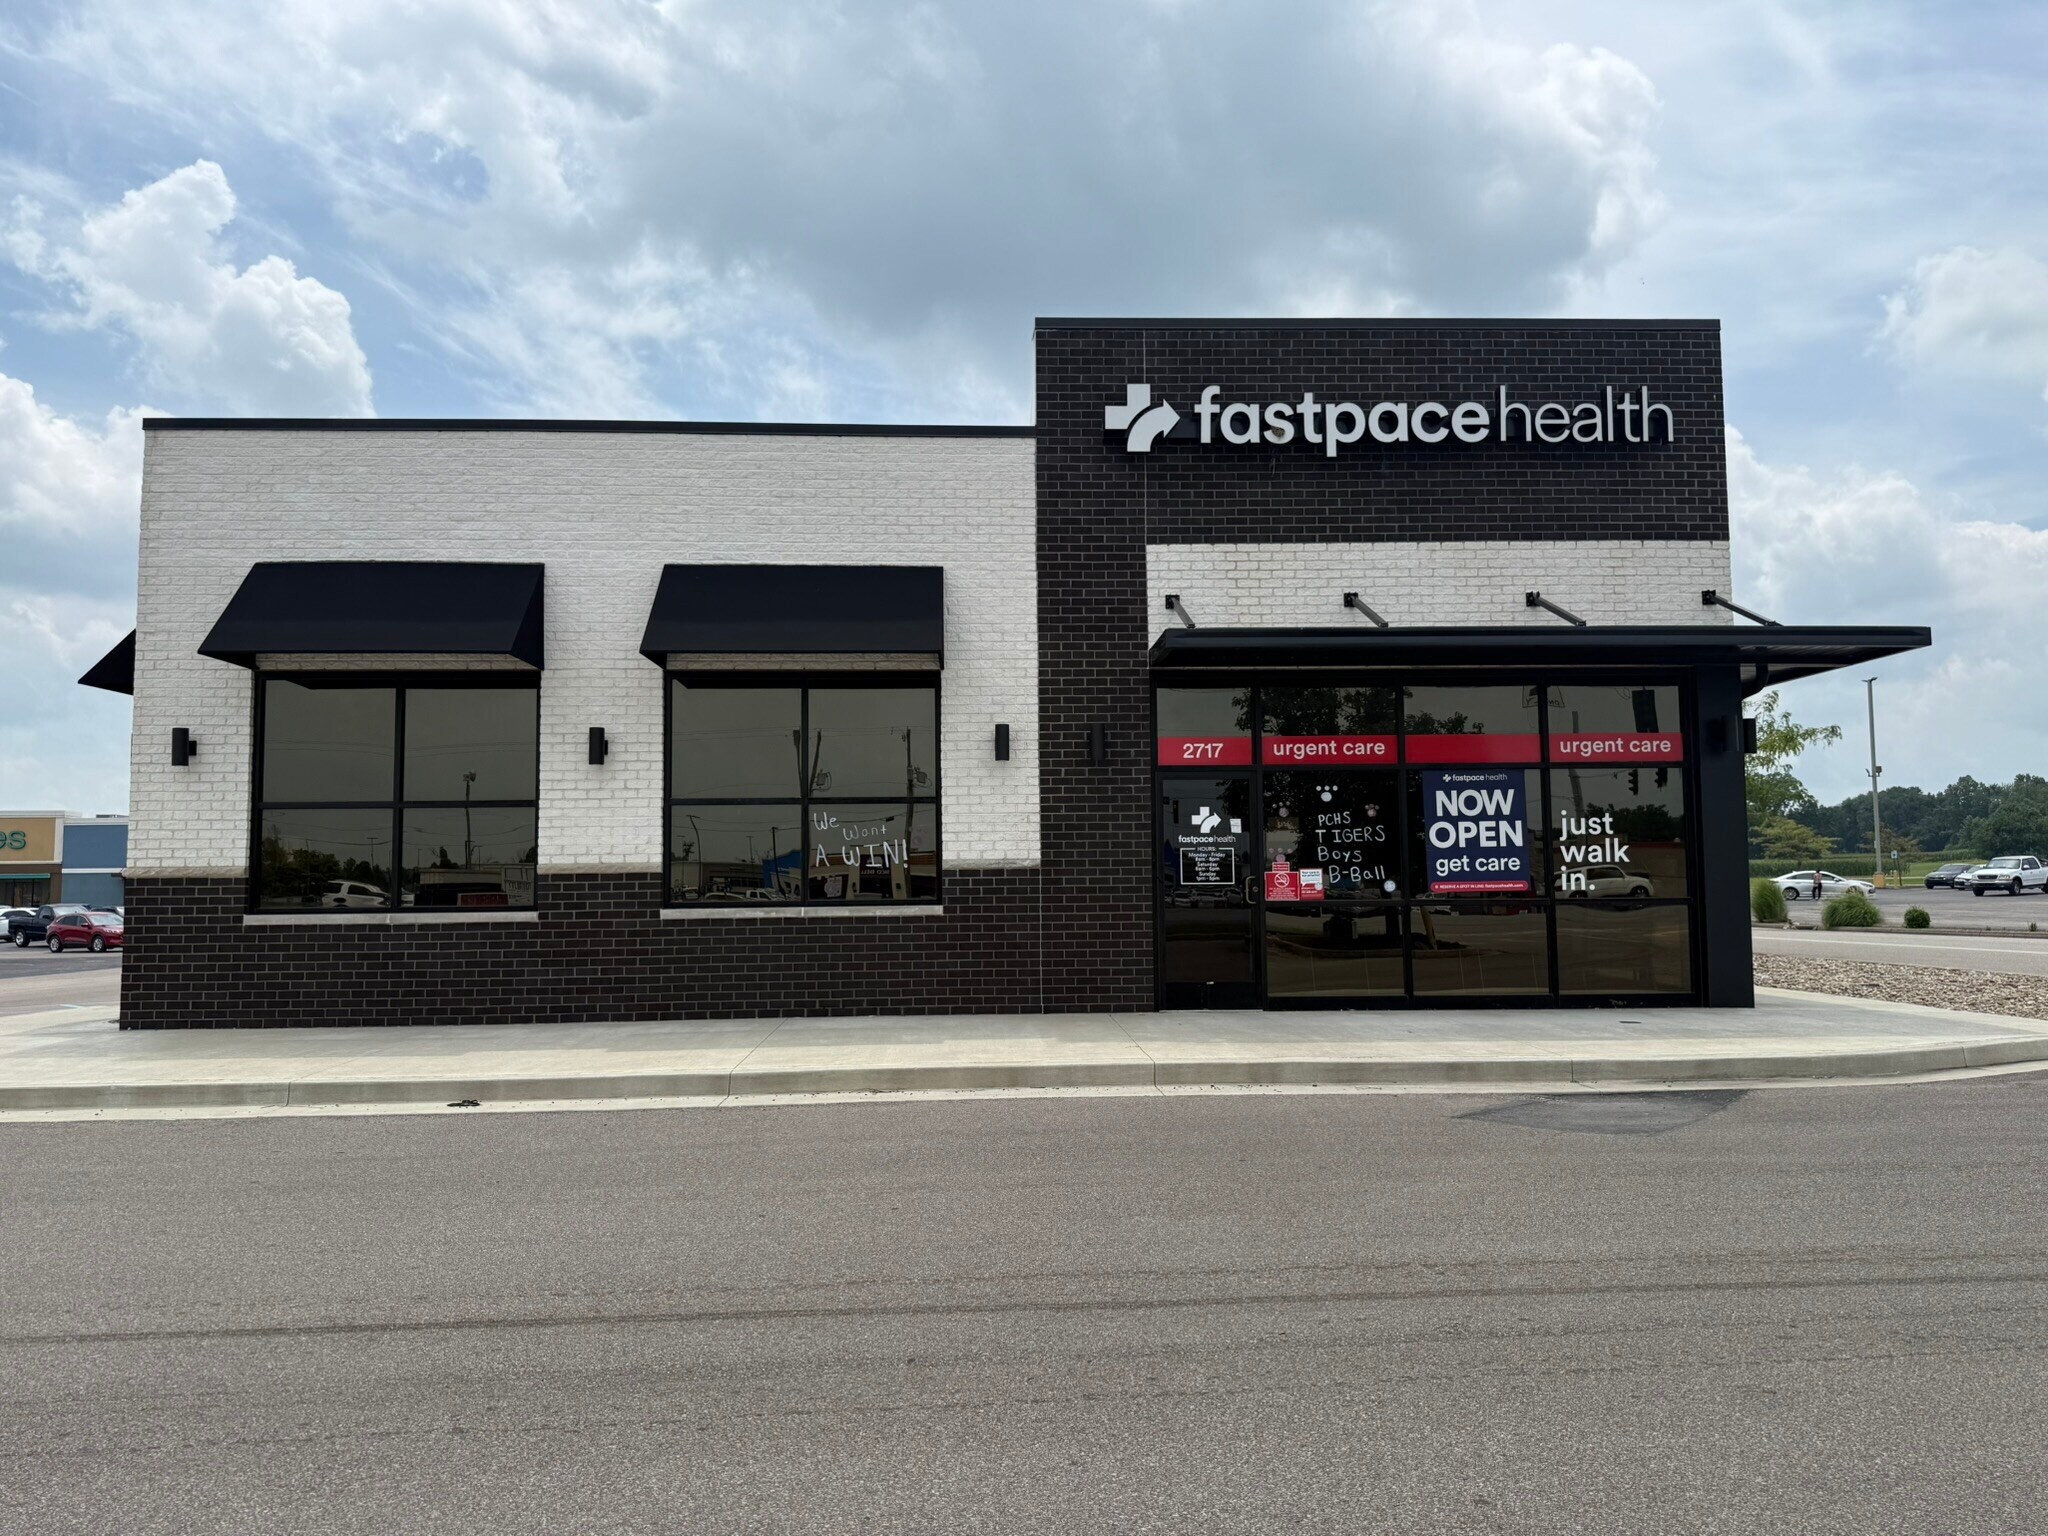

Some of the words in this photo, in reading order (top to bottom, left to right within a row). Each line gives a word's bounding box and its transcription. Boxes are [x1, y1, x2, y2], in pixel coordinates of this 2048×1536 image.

[1183, 743, 1224, 759] 2717
[1273, 740, 1337, 759] urgent
[1343, 742, 1385, 756] care
[1559, 738, 1624, 757] urgent
[1629, 739, 1672, 753] care
[1435, 788, 1515, 817] NOW
[813, 812, 840, 831] We
[1318, 811, 1351, 826] PCHS
[1559, 809, 1614, 841] just
[1315, 825, 1386, 844] TIGERS
[1428, 820, 1524, 849] OPEN
[815, 843, 829, 867] A
[842, 838, 908, 869] WIN!
[1318, 846, 1362, 863] Boys
[1560, 838, 1630, 863] walk
[1328, 865, 1386, 884] B-Ball
[1435, 855, 1470, 876] get
[1475, 857, 1521, 872] care
[1560, 865, 1596, 891] in.
